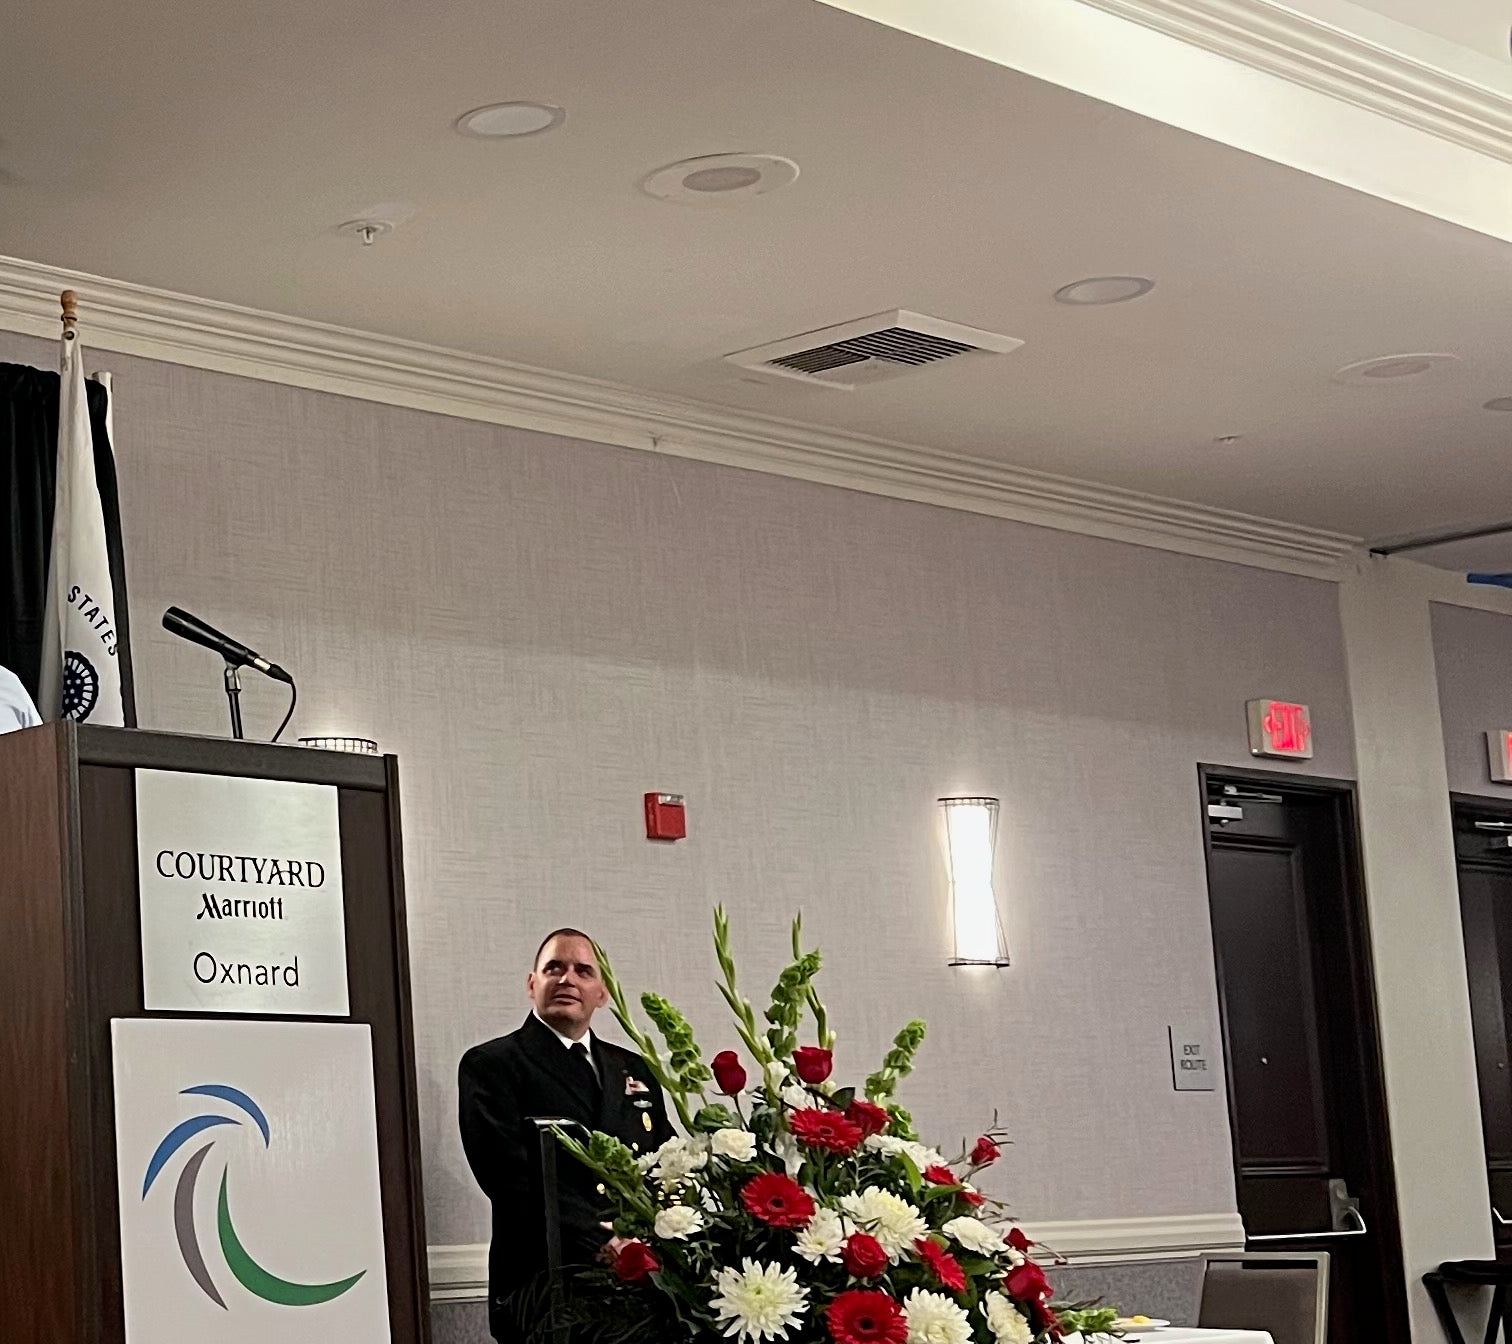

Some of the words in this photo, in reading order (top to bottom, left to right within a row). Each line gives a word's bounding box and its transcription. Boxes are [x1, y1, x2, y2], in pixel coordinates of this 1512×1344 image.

[67, 585, 118, 657] STATES
[156, 849, 325, 888] COURTYARD
[196, 892, 283, 920] Marriott
[193, 951, 299, 987] Oxnard
